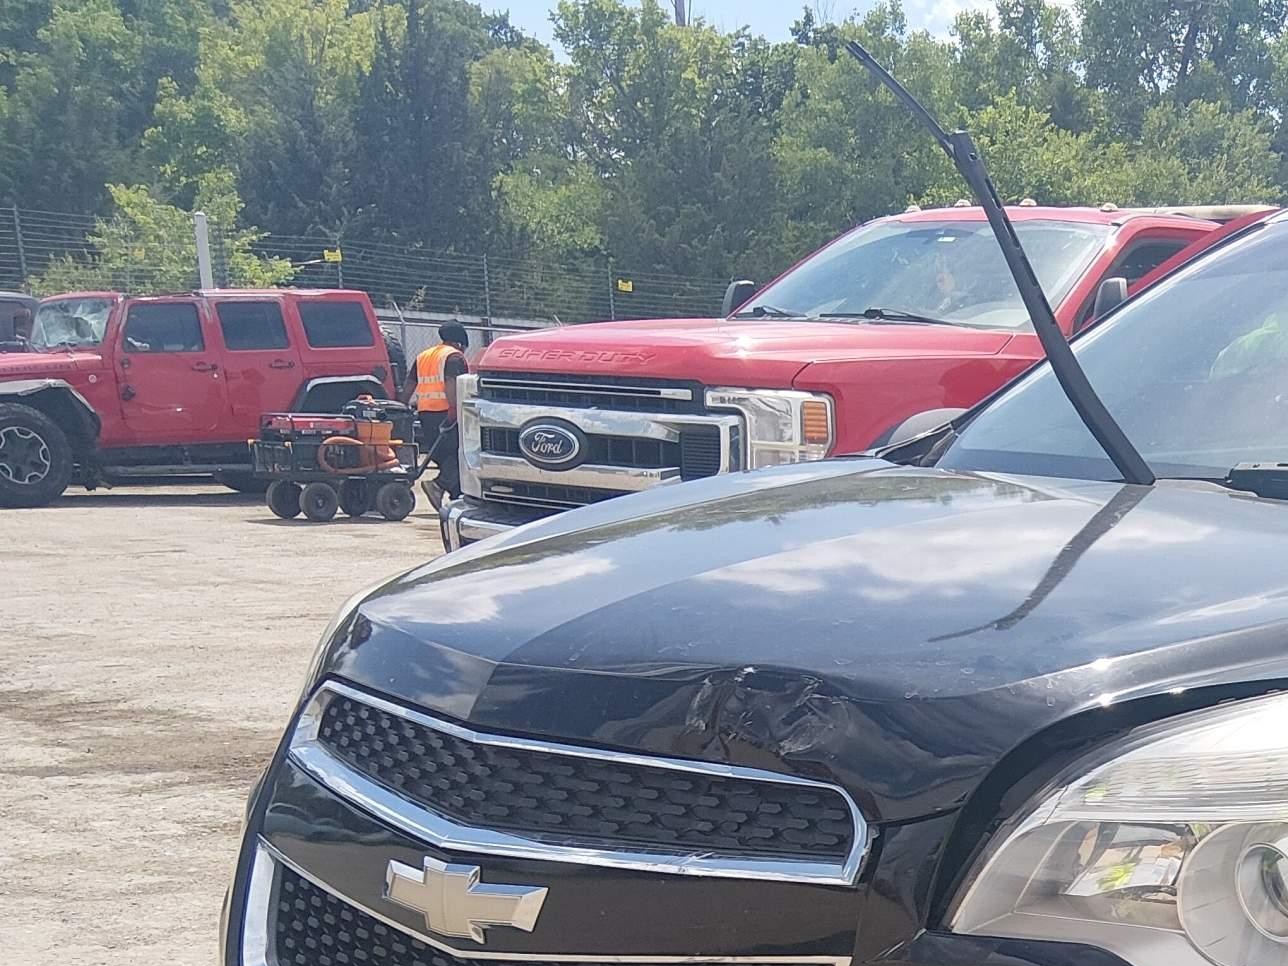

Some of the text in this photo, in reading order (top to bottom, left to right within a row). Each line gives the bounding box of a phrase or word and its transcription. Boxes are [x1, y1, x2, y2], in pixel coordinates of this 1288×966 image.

[499, 347, 657, 365] SUPER DUTY
[531, 431, 563, 455] Ford
